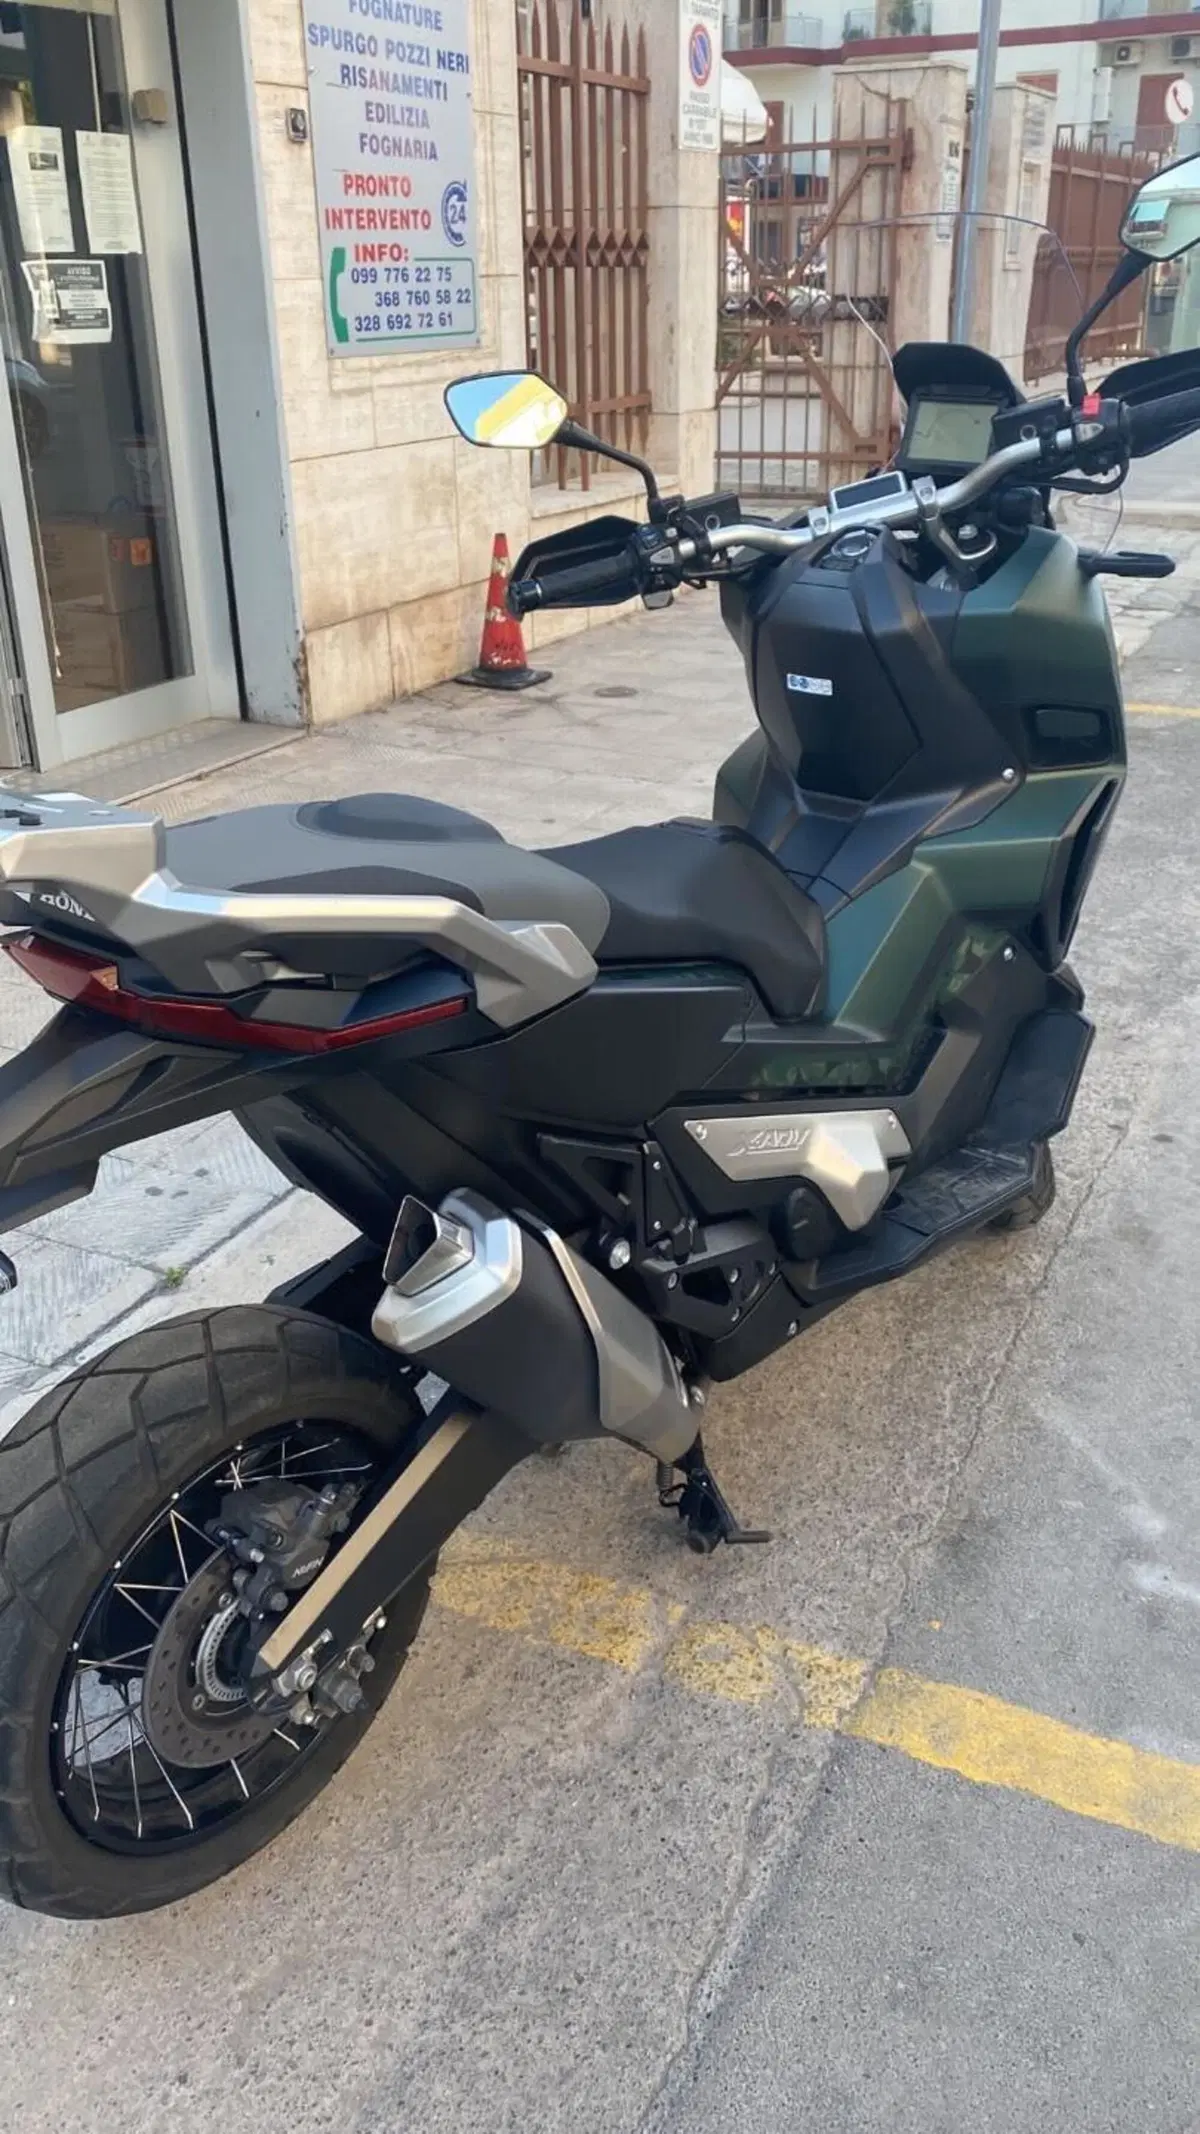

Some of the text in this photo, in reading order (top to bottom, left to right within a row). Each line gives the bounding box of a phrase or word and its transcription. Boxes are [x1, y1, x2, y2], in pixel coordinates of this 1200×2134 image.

[348, 0, 443, 31] FOGNATURE
[307, 22, 470, 74] SPURGO POZZI NERI
[340, 63, 448, 101] RISANAMENTI
[364, 100, 430, 129] EDILIZIA
[358, 132, 439, 161] FOGNARIA
[343, 174, 412, 198] PRONTO
[324, 207, 432, 231] INTERVENTO
[449, 204, 467, 224] 24
[354, 243, 409, 263] INFO:
[351, 266, 452, 284] 099 776 22 75
[374, 288, 471, 307] 368 760 58 22
[354, 311, 453, 332] 328 692 72 61
